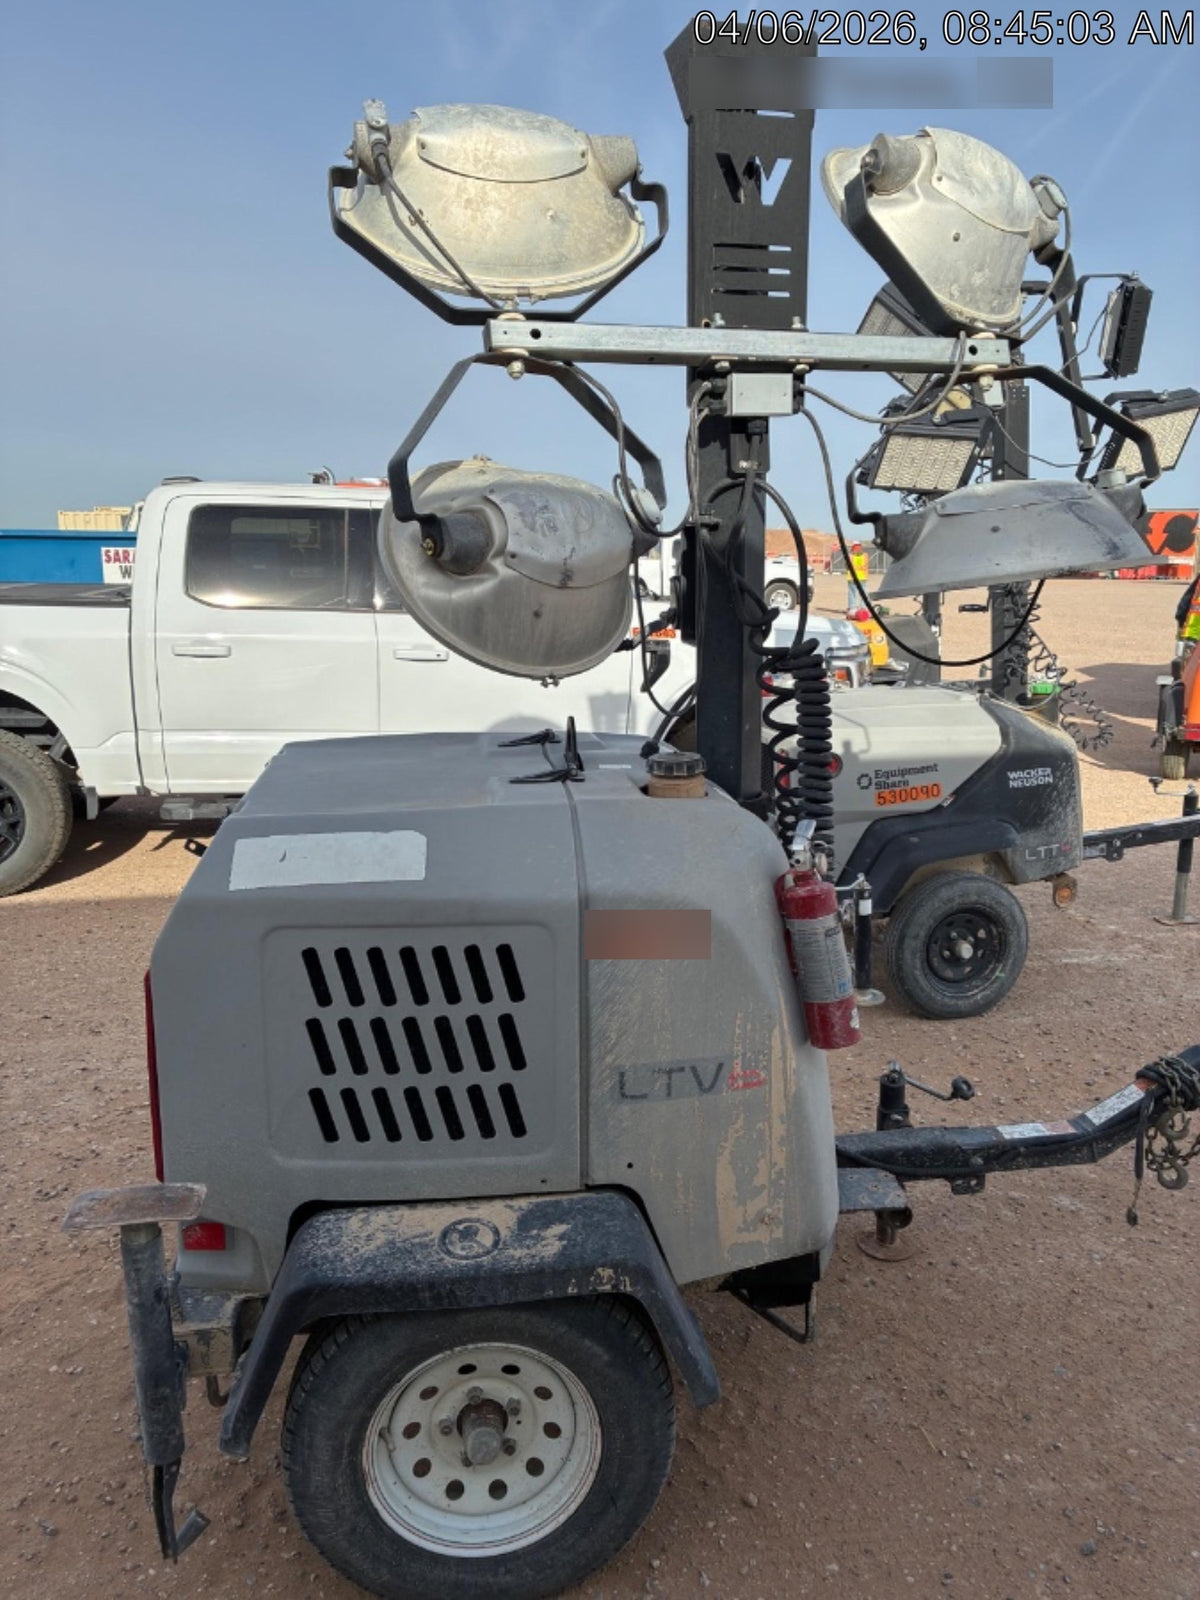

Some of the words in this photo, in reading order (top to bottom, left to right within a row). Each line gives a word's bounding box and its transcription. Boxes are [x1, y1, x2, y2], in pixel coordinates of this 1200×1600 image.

[874, 763, 939, 781] Equipment
[1007, 767, 1052, 780] WACKER
[1009, 774, 1054, 789] NEUSON
[876, 783, 941, 806] 530090
